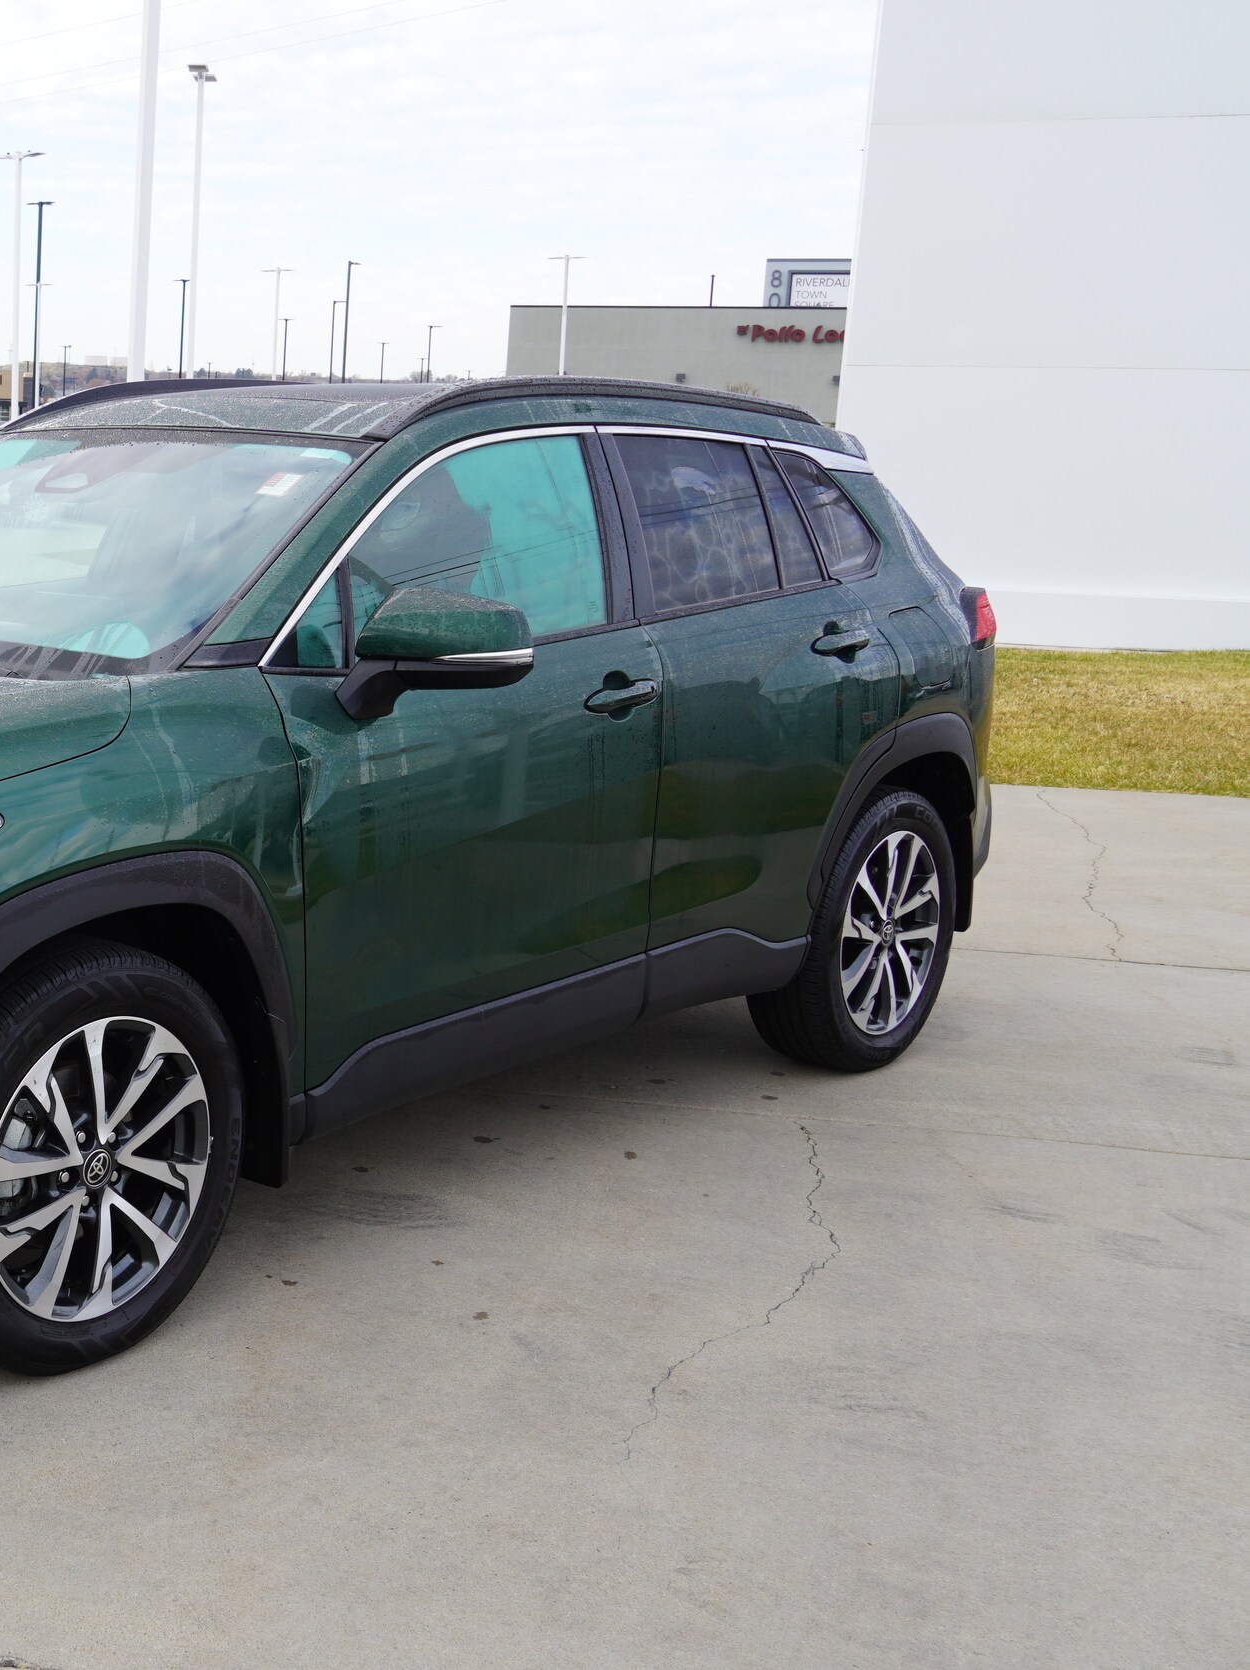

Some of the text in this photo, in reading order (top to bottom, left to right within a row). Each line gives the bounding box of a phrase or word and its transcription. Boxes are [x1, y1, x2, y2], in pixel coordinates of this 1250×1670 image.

[795, 277, 850, 288] RIVERDAL
[795, 290, 827, 299] TOWN
[751, 324, 806, 343] Pollo
